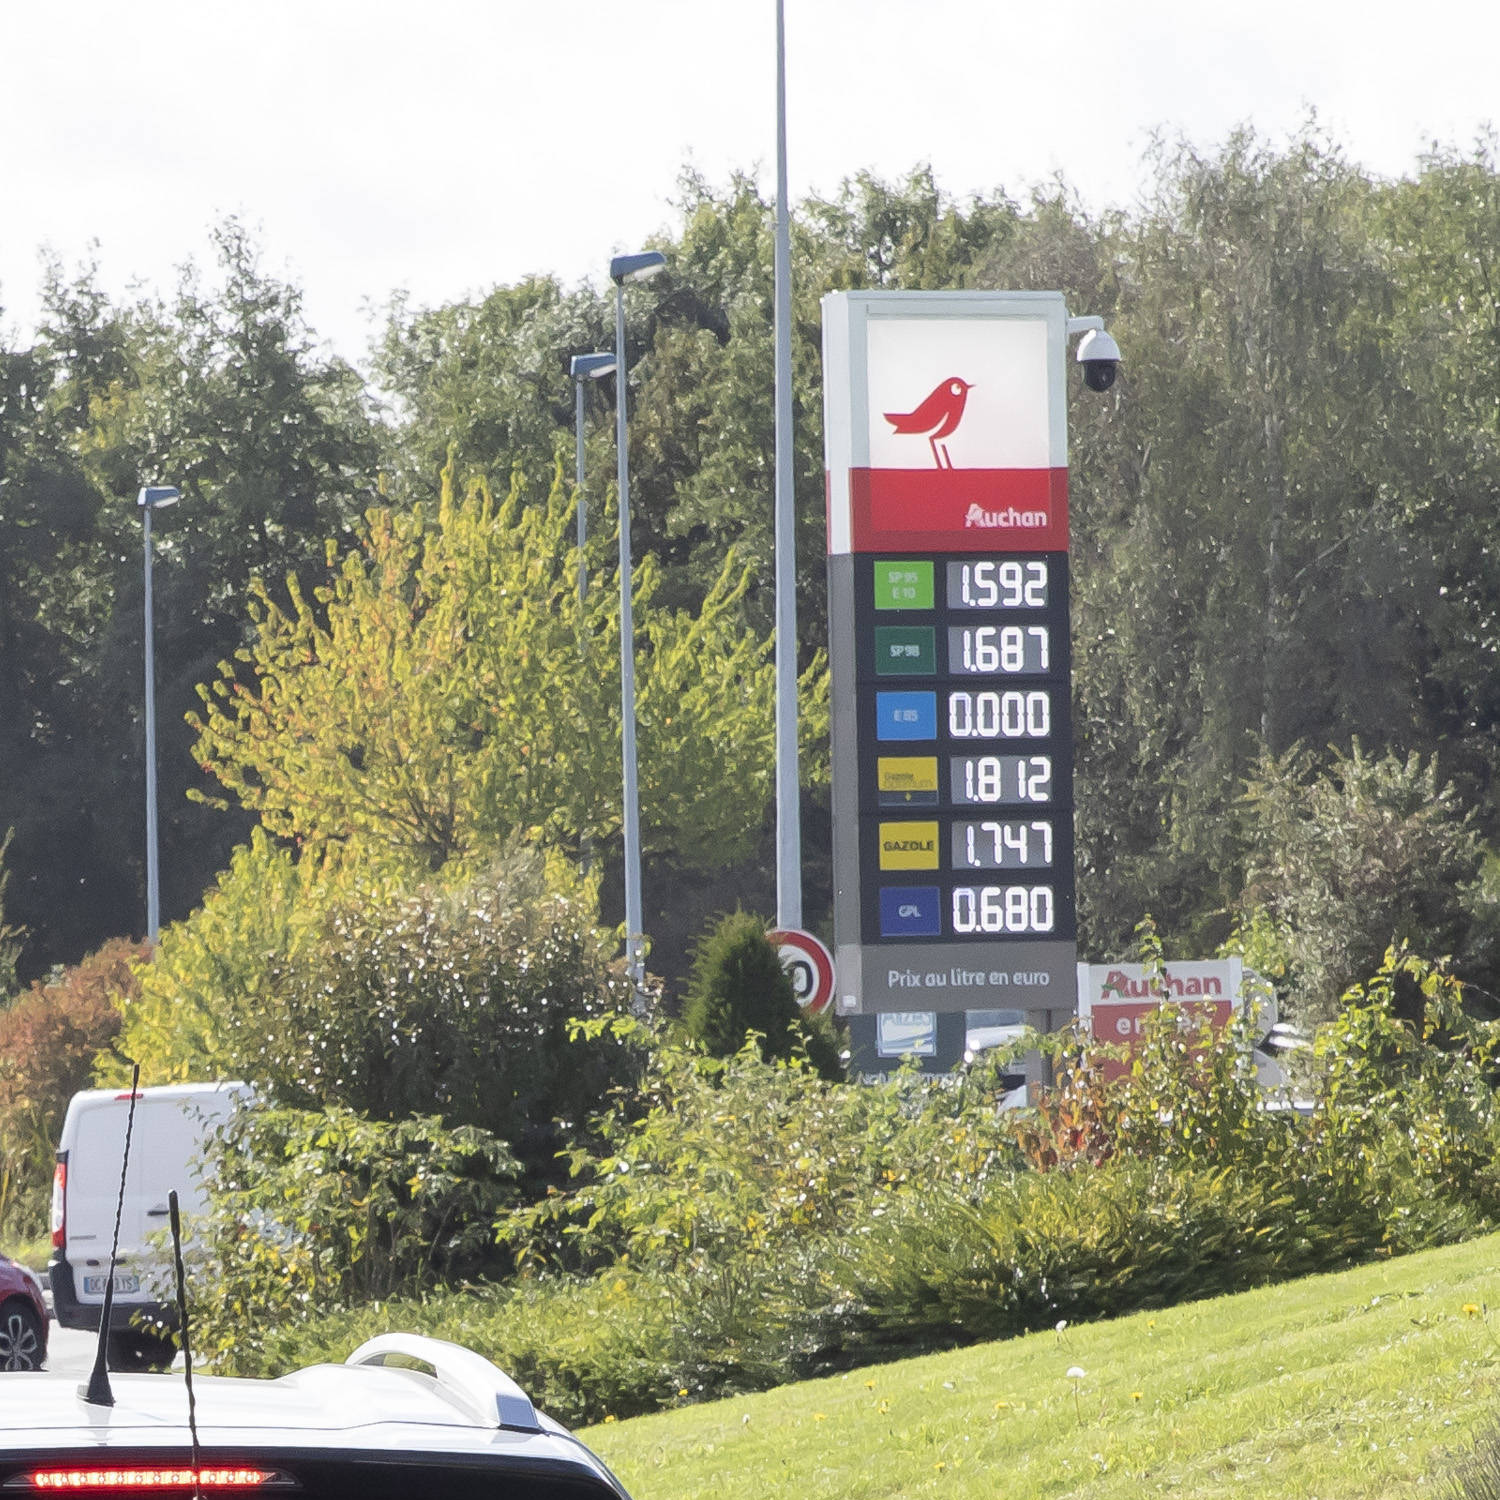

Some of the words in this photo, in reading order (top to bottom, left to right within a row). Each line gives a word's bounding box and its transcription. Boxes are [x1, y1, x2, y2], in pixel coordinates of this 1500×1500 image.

[965, 503, 1048, 528] Auchan
[962, 561, 1048, 607] 1.592
[963, 626, 1049, 672] 1.687
[949, 691, 1050, 737] 0.000
[965, 757, 1051, 802] 1.812
[883, 840, 935, 852] GAZOLE
[967, 822, 1052, 867] 1.747
[953, 887, 1053, 932] 0.680
[888, 969, 921, 988] Prix
[925, 971, 947, 987] au
[950, 968, 985, 986] litre
[989, 971, 1009, 985] en
[1013, 971, 1050, 986] euro
